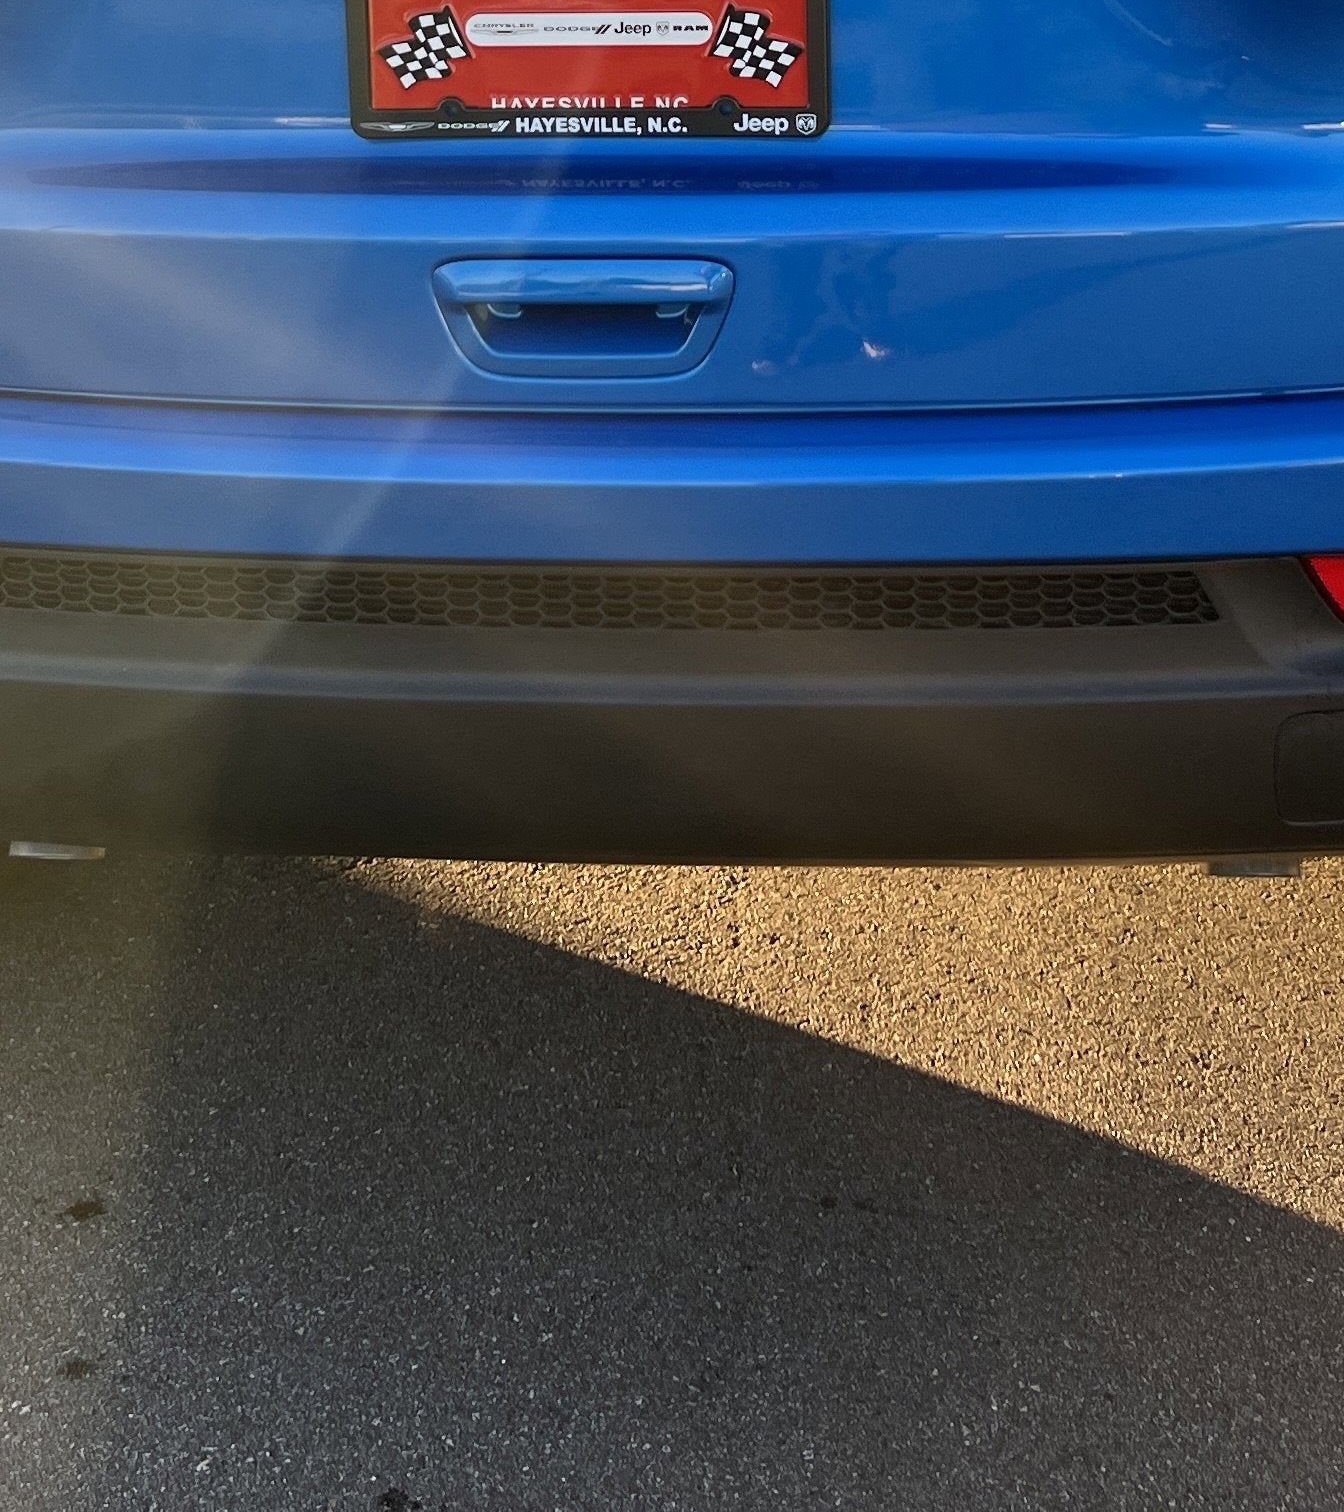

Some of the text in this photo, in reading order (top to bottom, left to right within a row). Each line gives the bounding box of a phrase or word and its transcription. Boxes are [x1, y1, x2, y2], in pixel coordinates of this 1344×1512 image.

[614, 21, 651, 36] Jeep
[515, 116, 688, 135] HAYESVILLE, N.C.
[733, 113, 790, 135] Jeep
